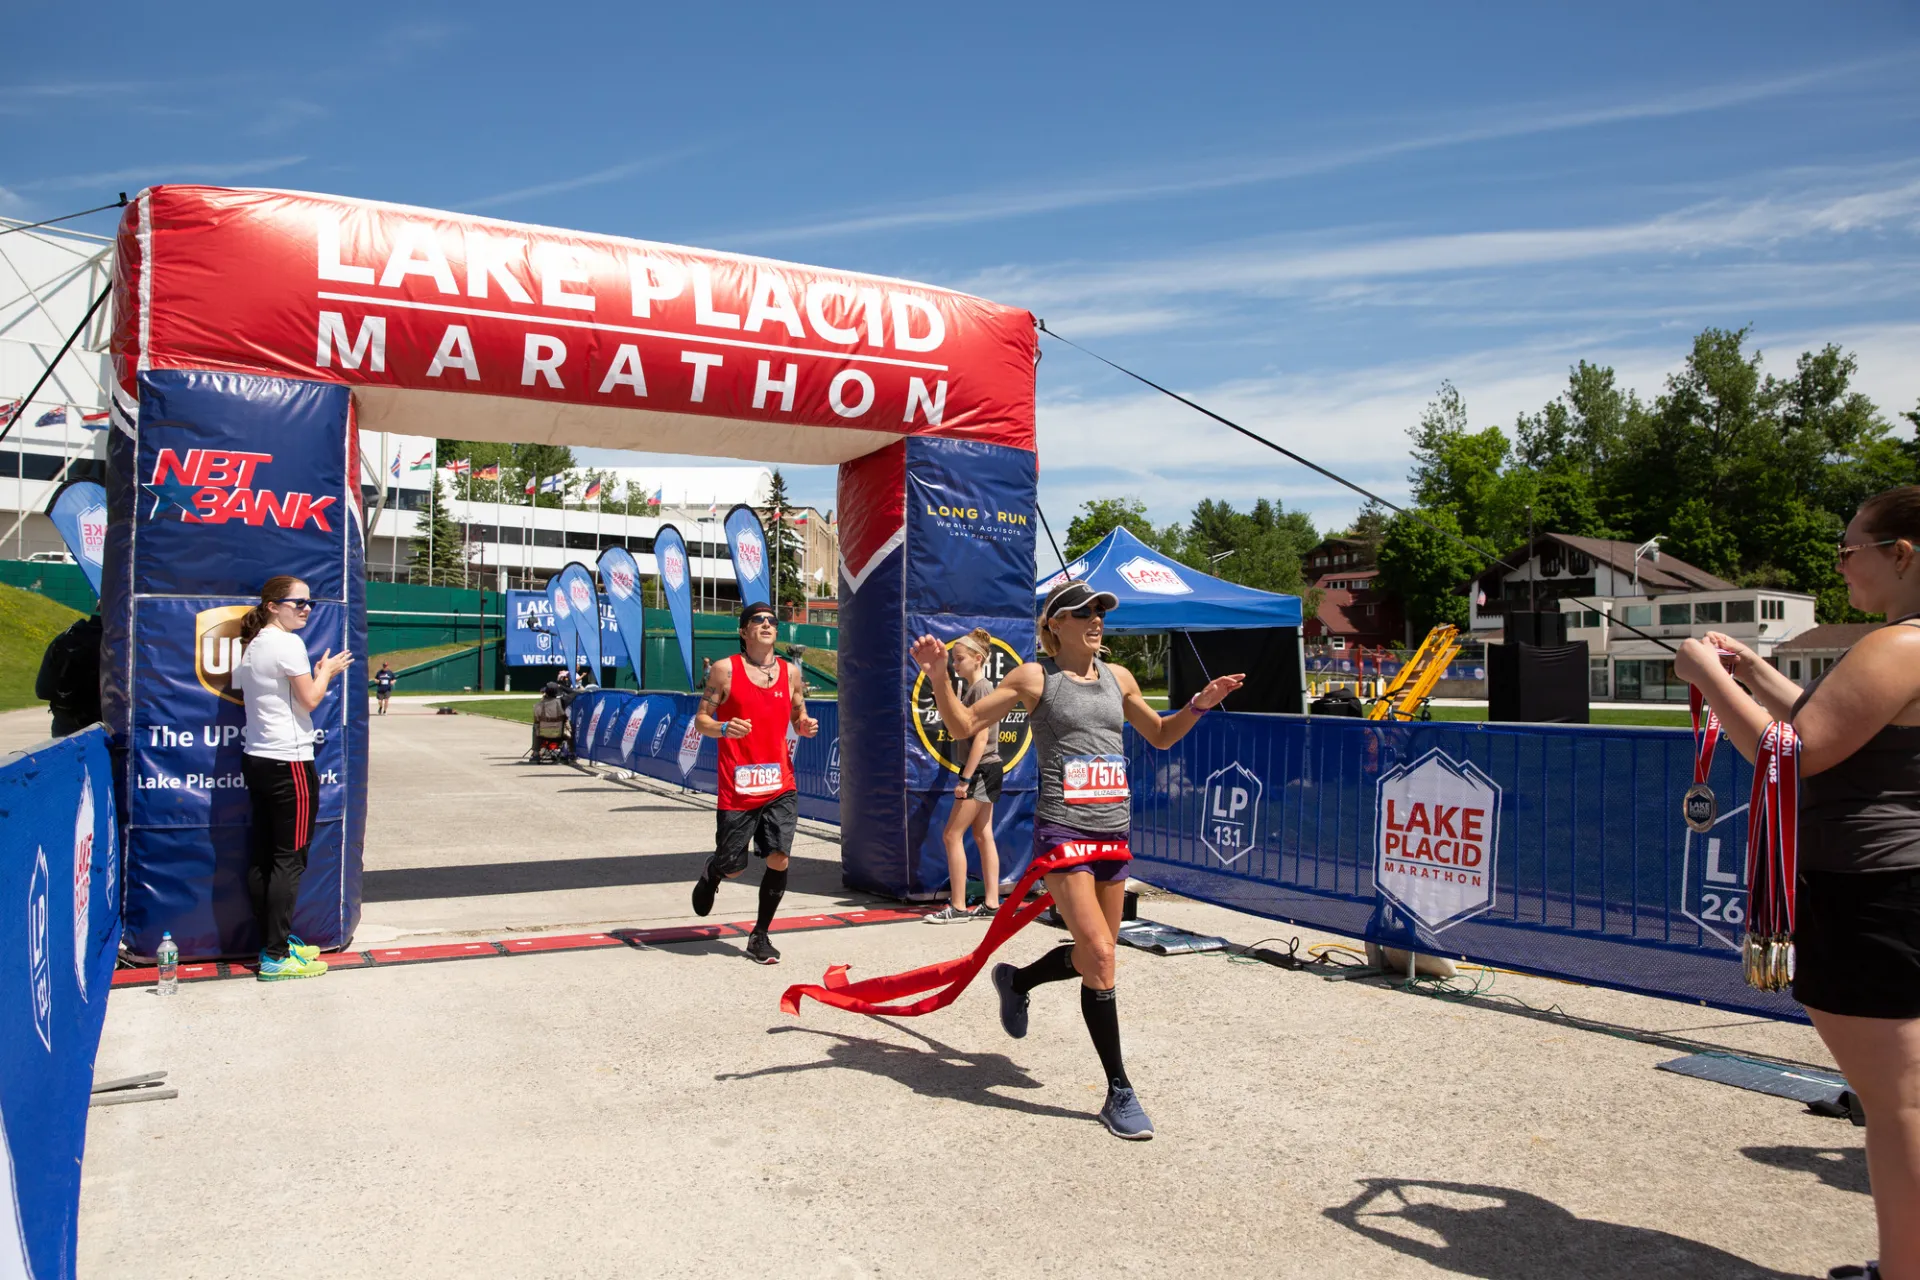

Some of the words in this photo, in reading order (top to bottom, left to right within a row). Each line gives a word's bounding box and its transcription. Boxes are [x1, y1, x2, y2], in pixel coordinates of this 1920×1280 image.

[316, 209, 596, 312] LAKE
[626, 254, 946, 353] PLACID
[316, 310, 948, 426] MARATHON
[151, 448, 274, 488] NBT
[181, 486, 337, 532] BANK
[927, 505, 978, 519] LONG
[997, 512, 1027, 525] RUN
[936, 520, 974, 530] Wealth
[979, 525, 1021, 536] Advisors
[1127, 569, 1175, 579] LAKE
[517, 600, 553, 616] LAK
[149, 725, 194, 747] The
[998, 731, 1017, 743] 996
[137, 773, 181, 789] Lake
[751, 768, 781, 786] 7692
[1089, 761, 1125, 787] 7575
[1211, 785, 1248, 819] LP
[1386, 799, 1486, 843] LAKE
[1212, 825, 1241, 848] 13.1
[1385, 832, 1483, 867] PLACID
[1384, 861, 1482, 887] MARATHON
